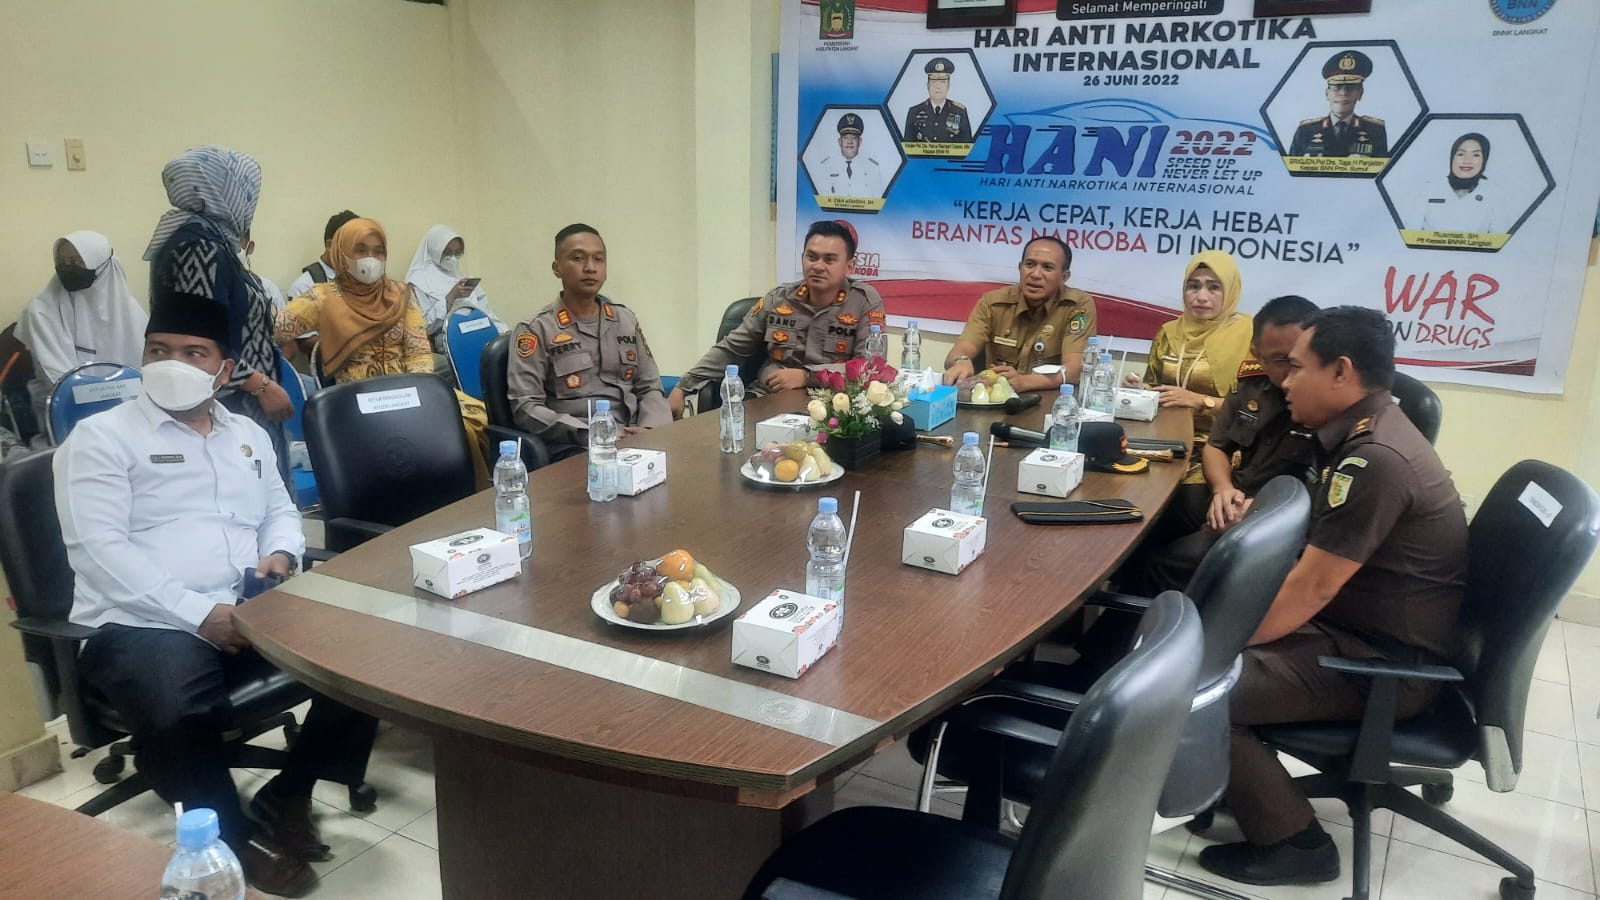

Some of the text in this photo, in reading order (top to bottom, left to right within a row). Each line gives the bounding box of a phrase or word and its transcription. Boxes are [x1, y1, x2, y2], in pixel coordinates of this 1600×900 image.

[1072, 0, 1207, 14] Selamat Memperingati
[974, 17, 1317, 48] HARI ANTI NARKOTIKA
[1013, 48, 1261, 72] INTERNASIONAL
[1083, 74, 1179, 86] 26 JUNI 2022
[983, 124, 1170, 178] HANI
[1170, 130, 1257, 156] 2022
[1162, 168, 1263, 181] NEVER LET UP
[1166, 157, 1236, 169] SPEED UP
[980, 177, 1256, 196] HARI ANTI NARKOTIKA INTERNASIONAL
[953, 199, 1299, 235] “KERJA CEPAT, KERJA HEBAT
[912, 220, 1023, 245] BERANTAS
[1157, 233, 1181, 255] DI
[854, 267, 880, 277] KOBA
[1384, 266, 1500, 325] WAR
[828, 325, 857, 337] POLR
[1415, 322, 1495, 350] DRUGS
